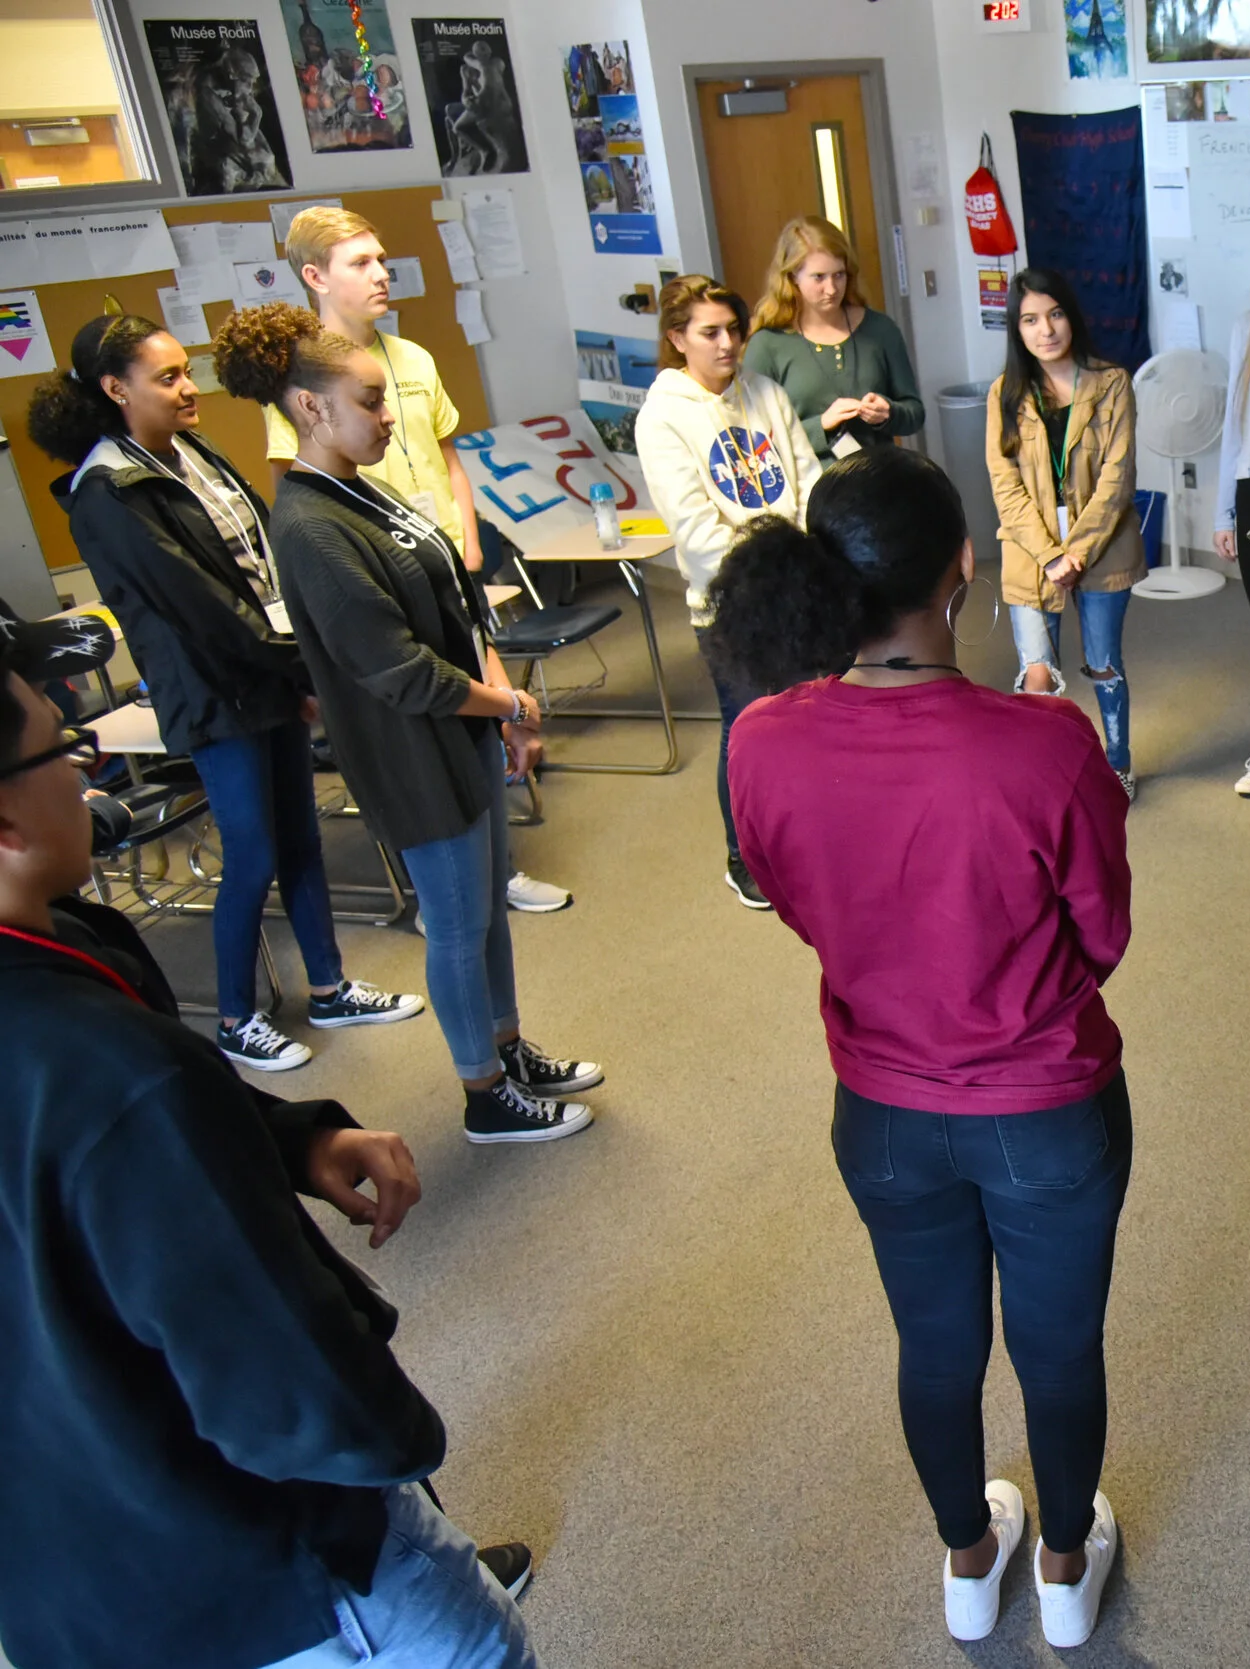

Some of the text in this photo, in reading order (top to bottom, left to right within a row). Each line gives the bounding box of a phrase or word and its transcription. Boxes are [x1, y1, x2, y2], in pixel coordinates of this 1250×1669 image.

[170, 25, 257, 40] Musée Rodin
[434, 22, 503, 36] Musée Rodin
[35, 231, 47, 239] du
[51, 228, 83, 238] monde
[90, 222, 149, 234] francophone
